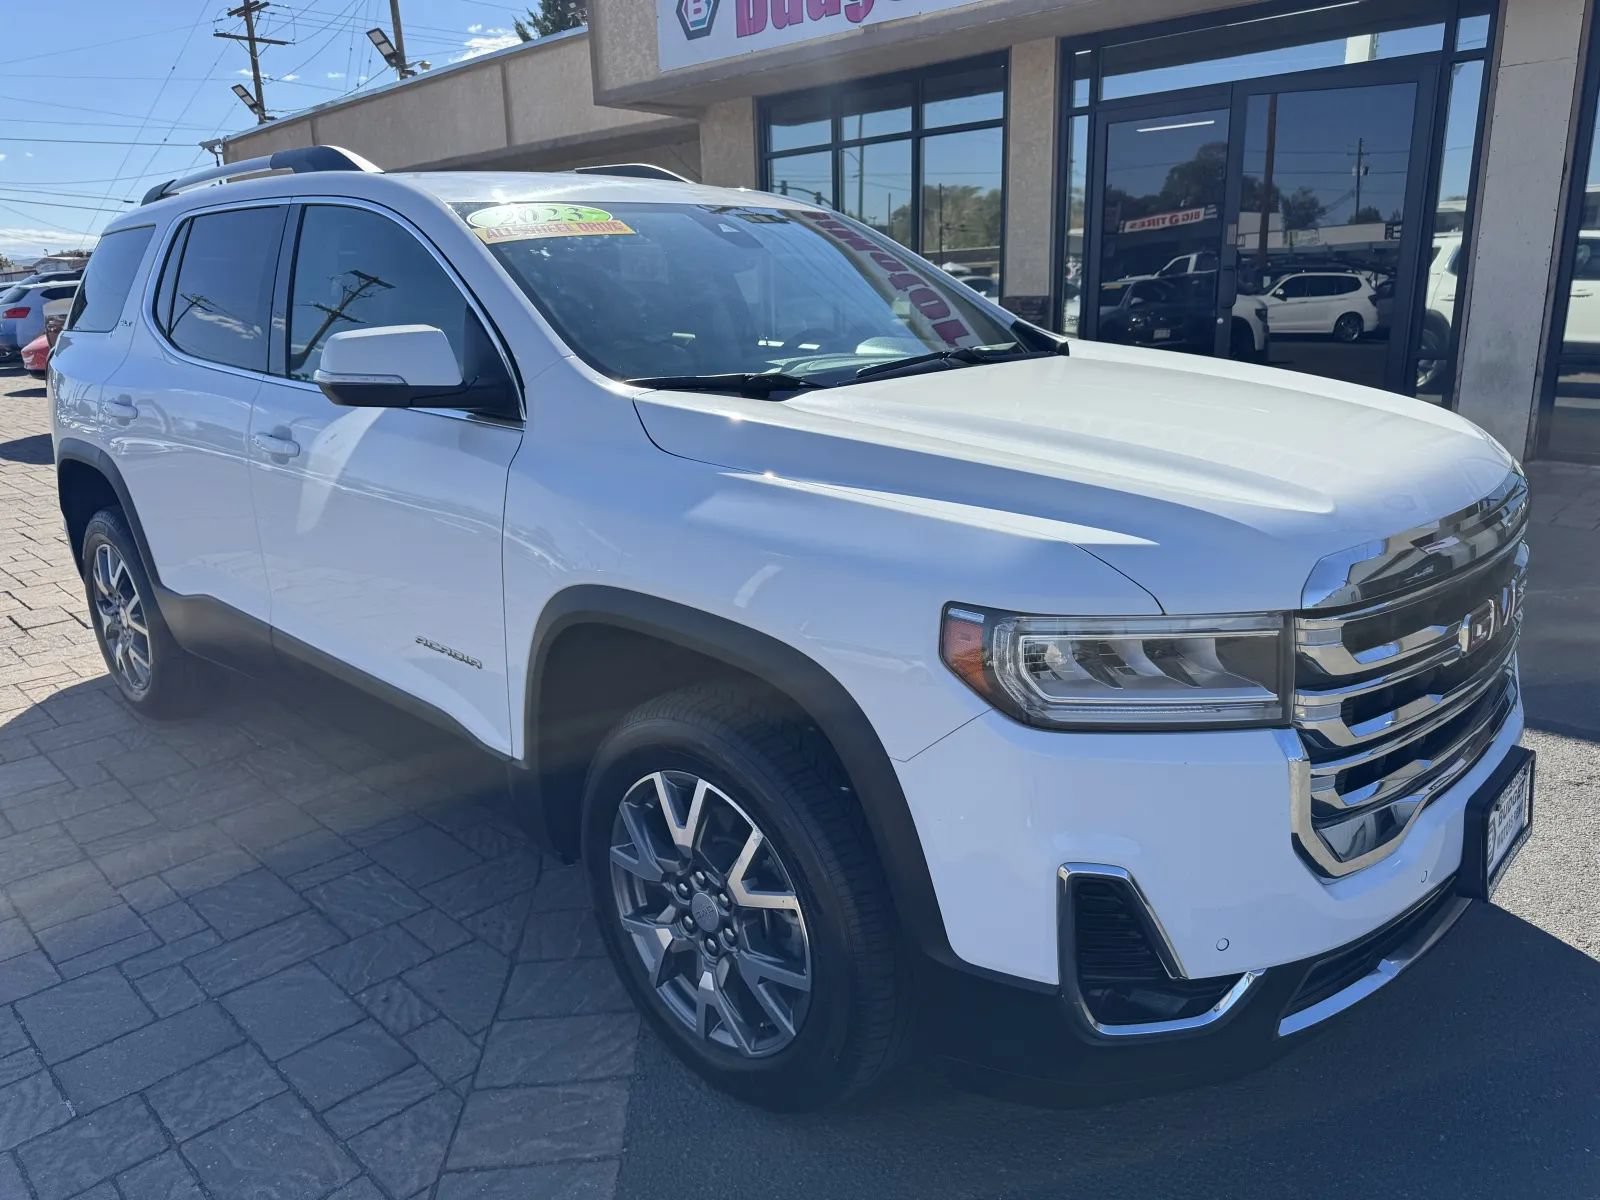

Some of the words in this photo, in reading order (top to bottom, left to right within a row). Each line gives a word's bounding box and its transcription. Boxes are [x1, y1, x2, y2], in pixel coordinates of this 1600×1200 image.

[500, 207, 584, 225] 2023
[576, 221, 624, 232] DRIVE
[415, 635, 482, 670] ACADIA
